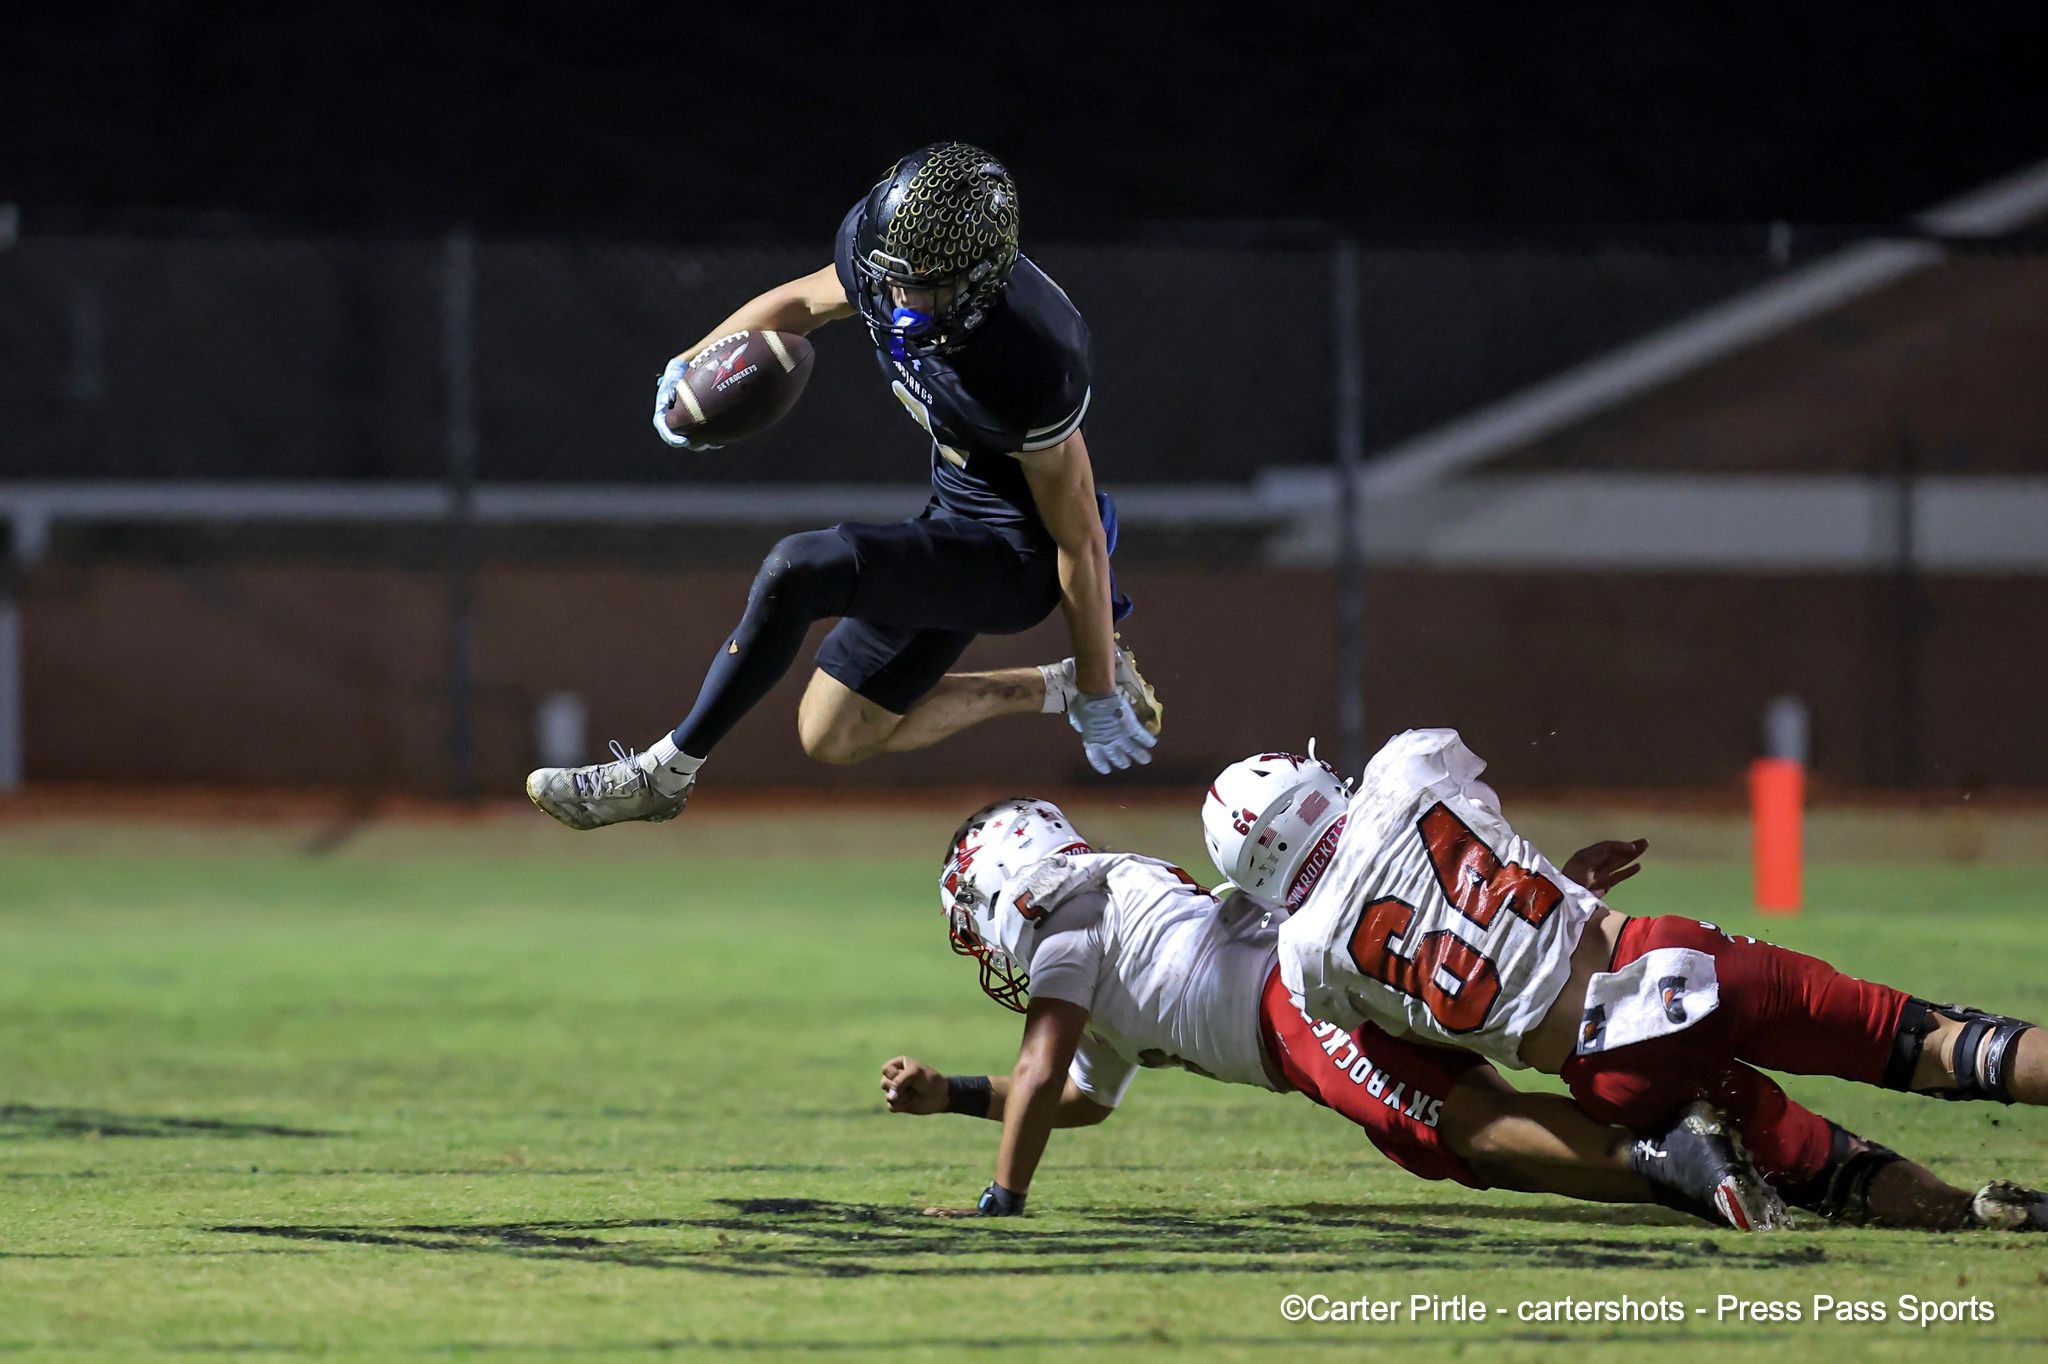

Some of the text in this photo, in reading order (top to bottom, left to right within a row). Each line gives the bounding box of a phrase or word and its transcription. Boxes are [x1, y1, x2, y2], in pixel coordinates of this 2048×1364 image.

[716, 364, 758, 392] SKYROCKETS
[1232, 807, 1259, 837] 64
[1287, 818, 1347, 909] SKYROCKETS
[1346, 800, 1565, 1035] 64
